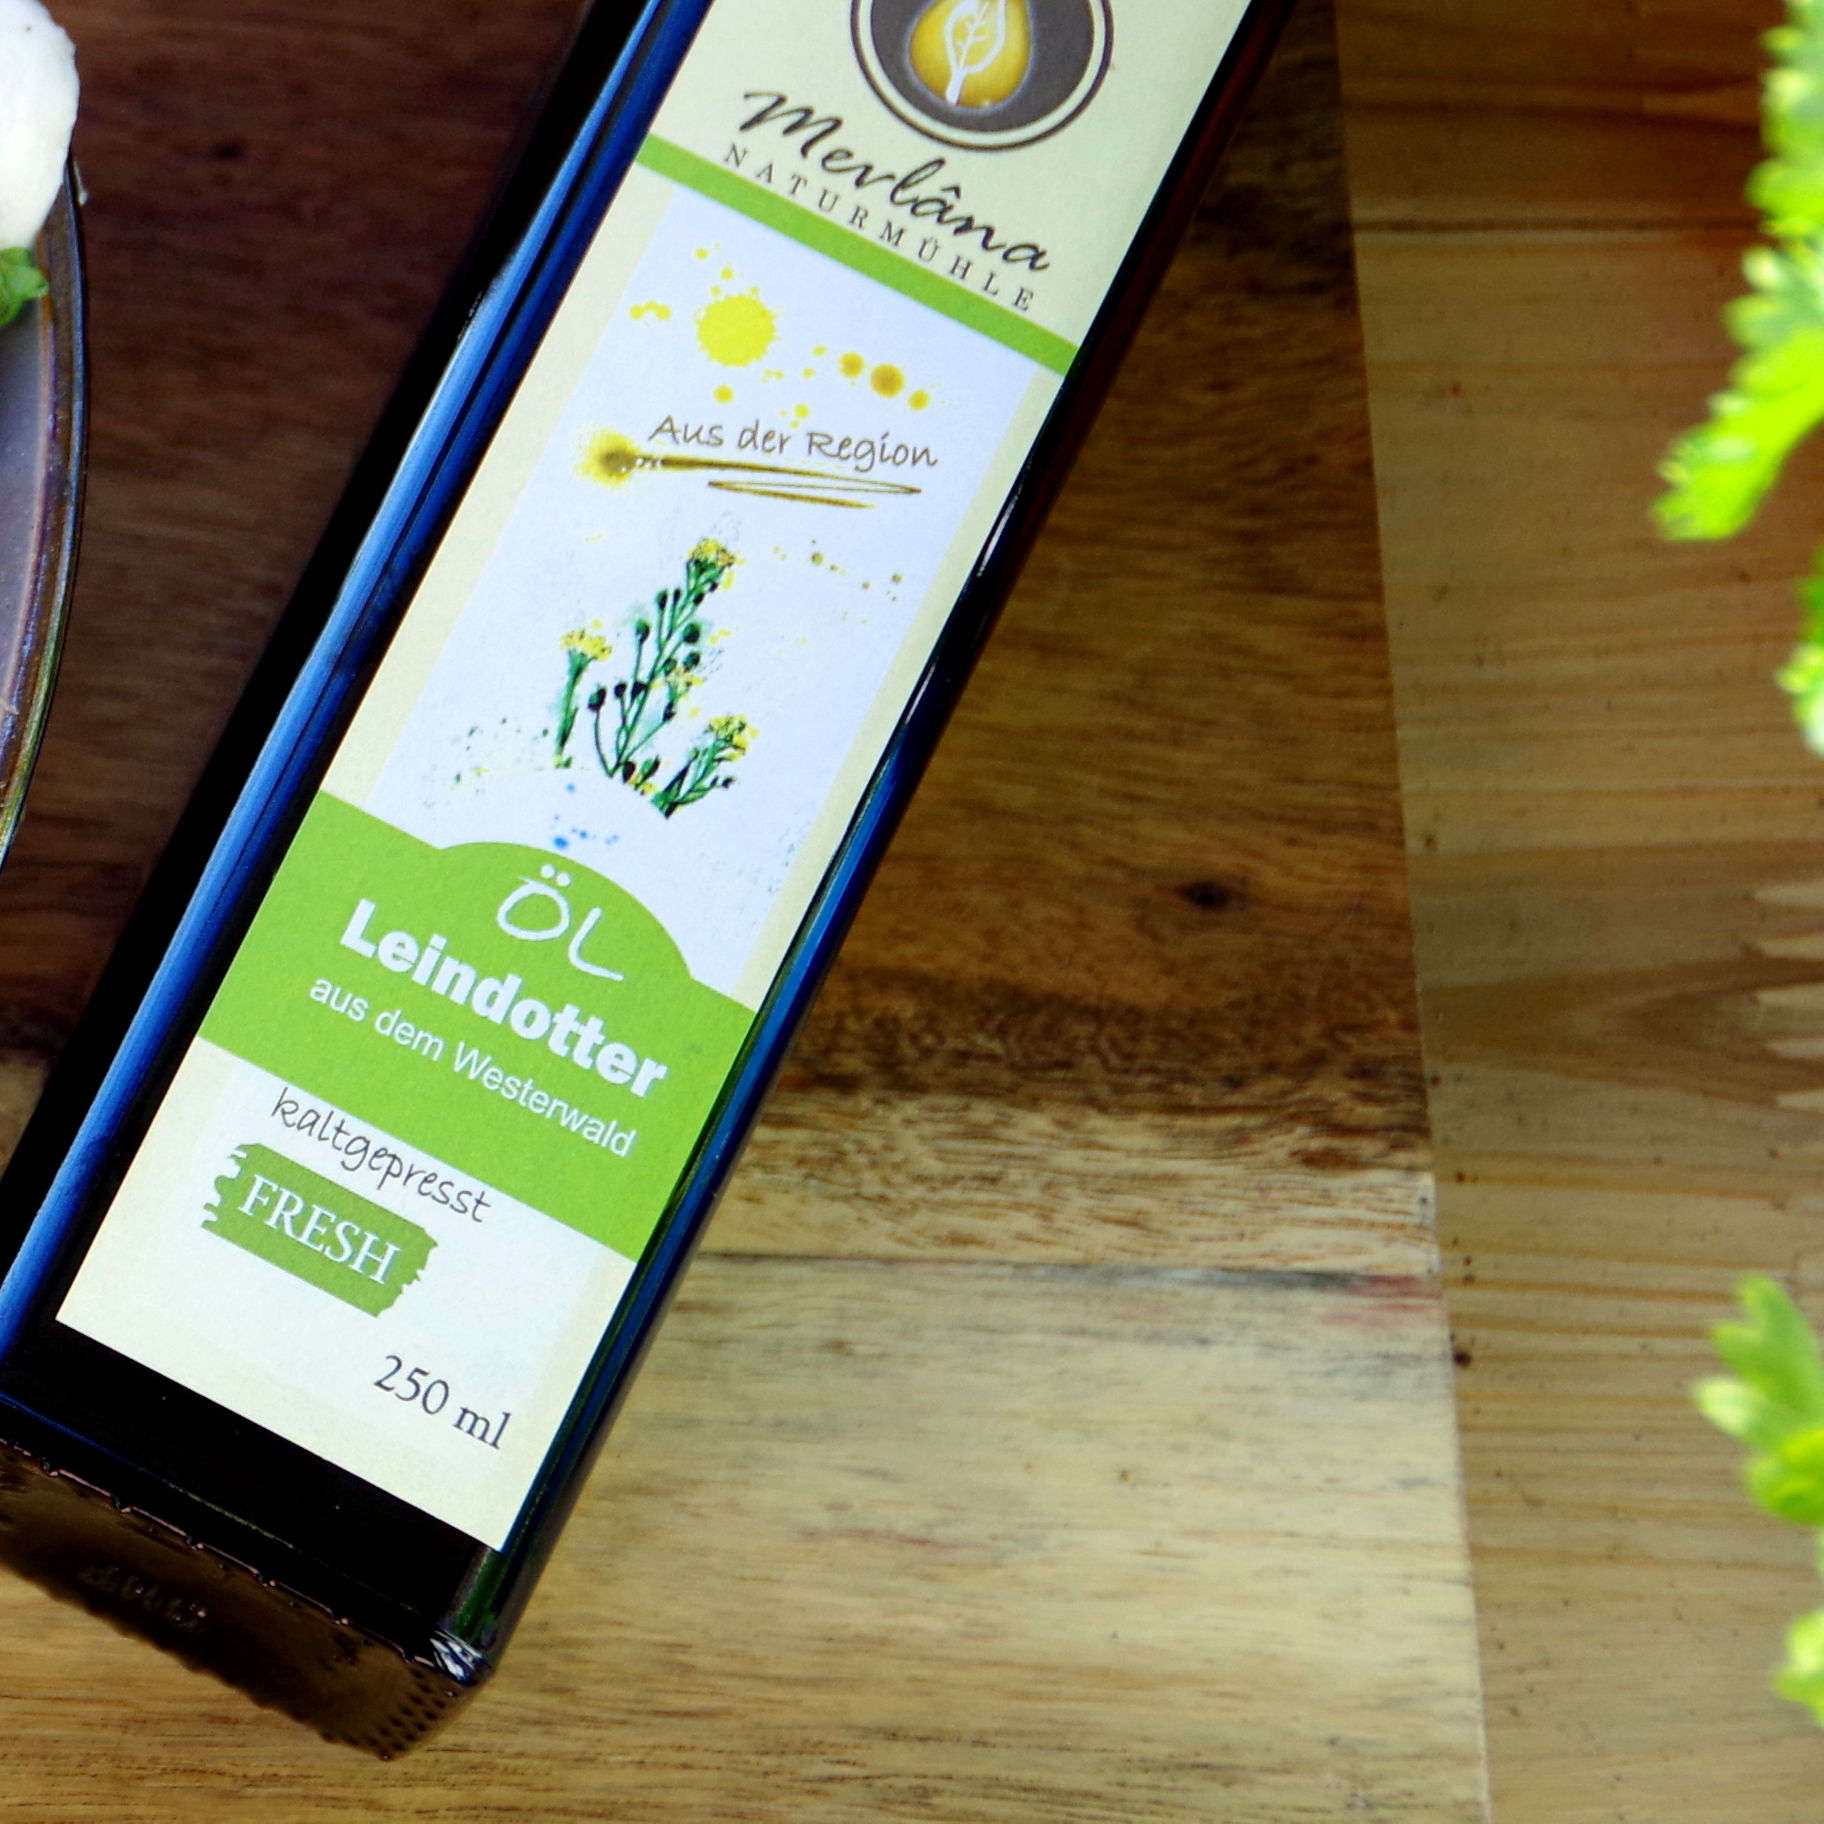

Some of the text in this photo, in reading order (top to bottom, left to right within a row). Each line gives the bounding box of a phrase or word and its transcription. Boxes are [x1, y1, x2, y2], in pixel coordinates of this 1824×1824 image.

[723, 143, 1036, 313] NATURMÜHLE
[739, 88, 1051, 273] Mevlâna
[649, 414, 939, 472] Aus der Region
[496, 863, 624, 982] ÖL
[310, 973, 637, 1159] aus dem Westerwald
[338, 898, 668, 1100] Leindotter
[271, 1086, 493, 1224] kaltgepresst
[239, 1172, 401, 1286] FRESH
[372, 1354, 512, 1451] 250 ml
